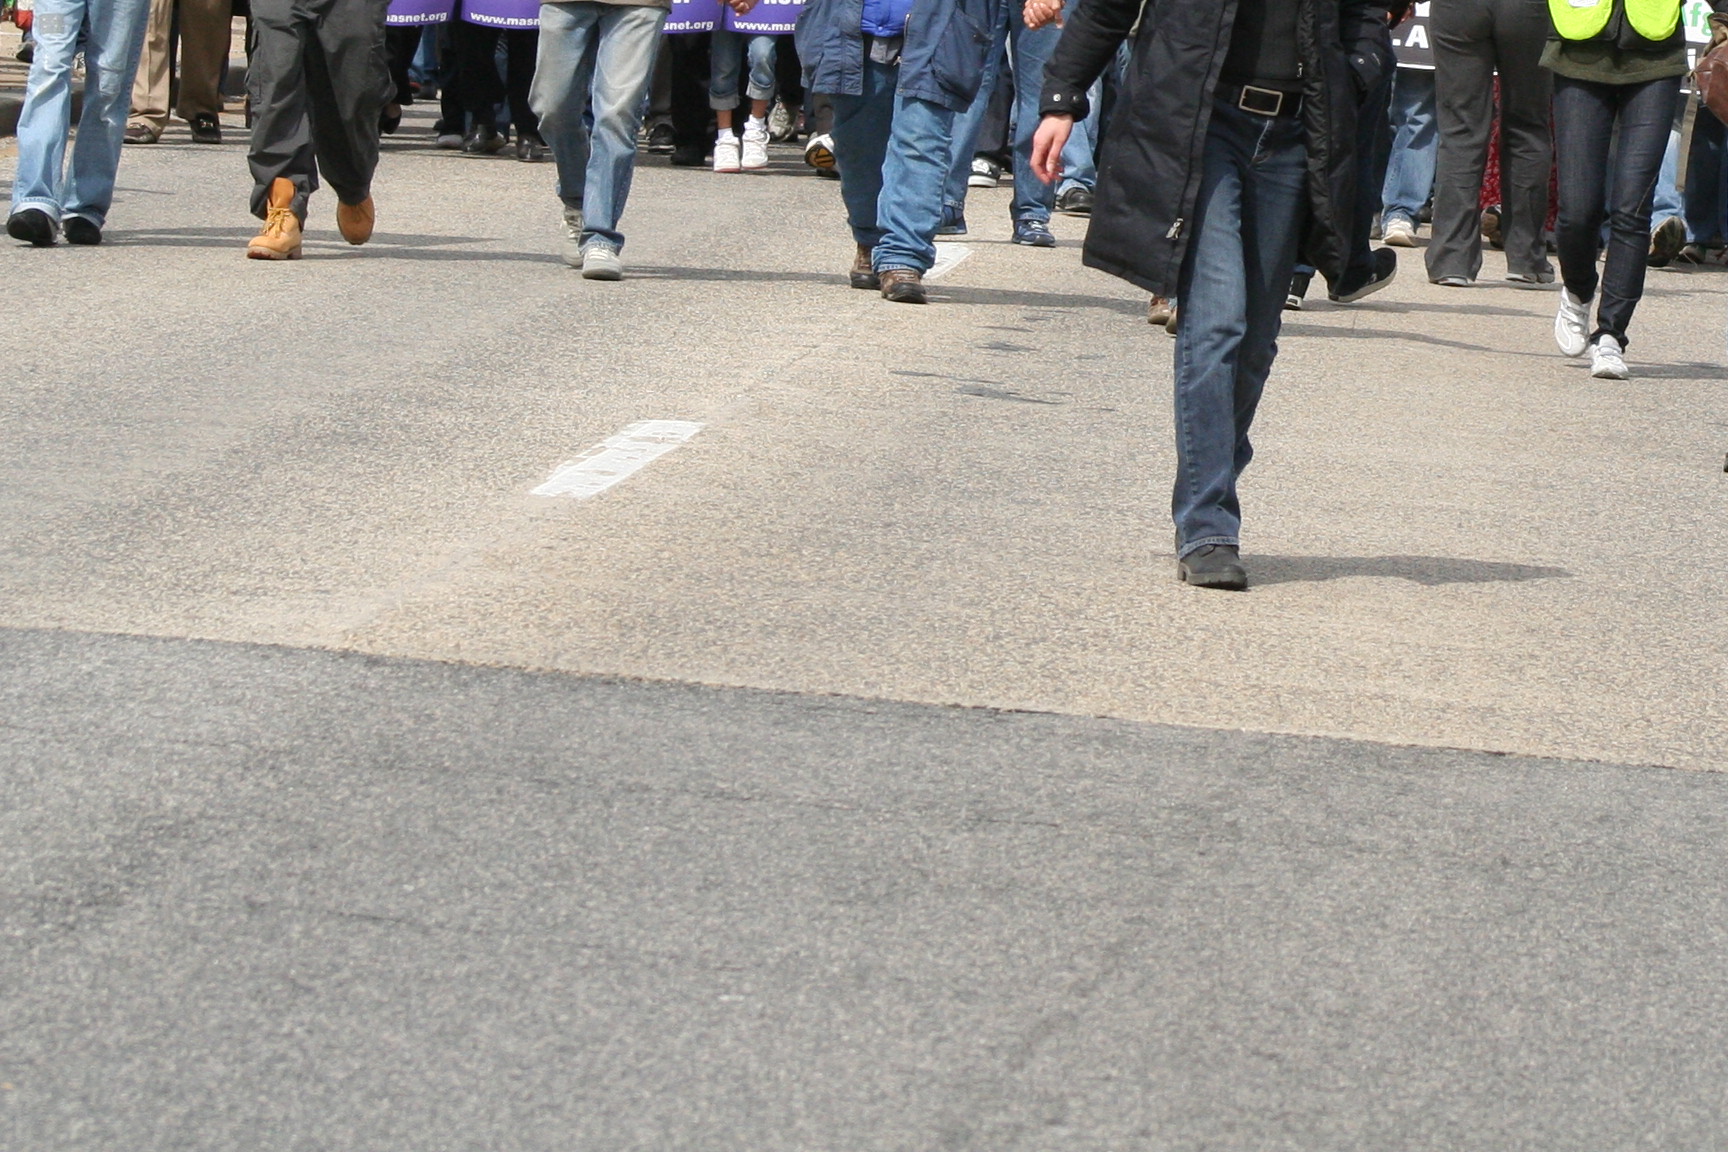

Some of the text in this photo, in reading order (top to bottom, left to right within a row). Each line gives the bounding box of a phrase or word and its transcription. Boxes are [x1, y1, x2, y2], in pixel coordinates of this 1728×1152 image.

[386, 12, 448, 23] asnet.org
[470, 12, 541, 26] www.masn
[663, 20, 714, 31] snet.org
[734, 21, 796, 32] www.mas
